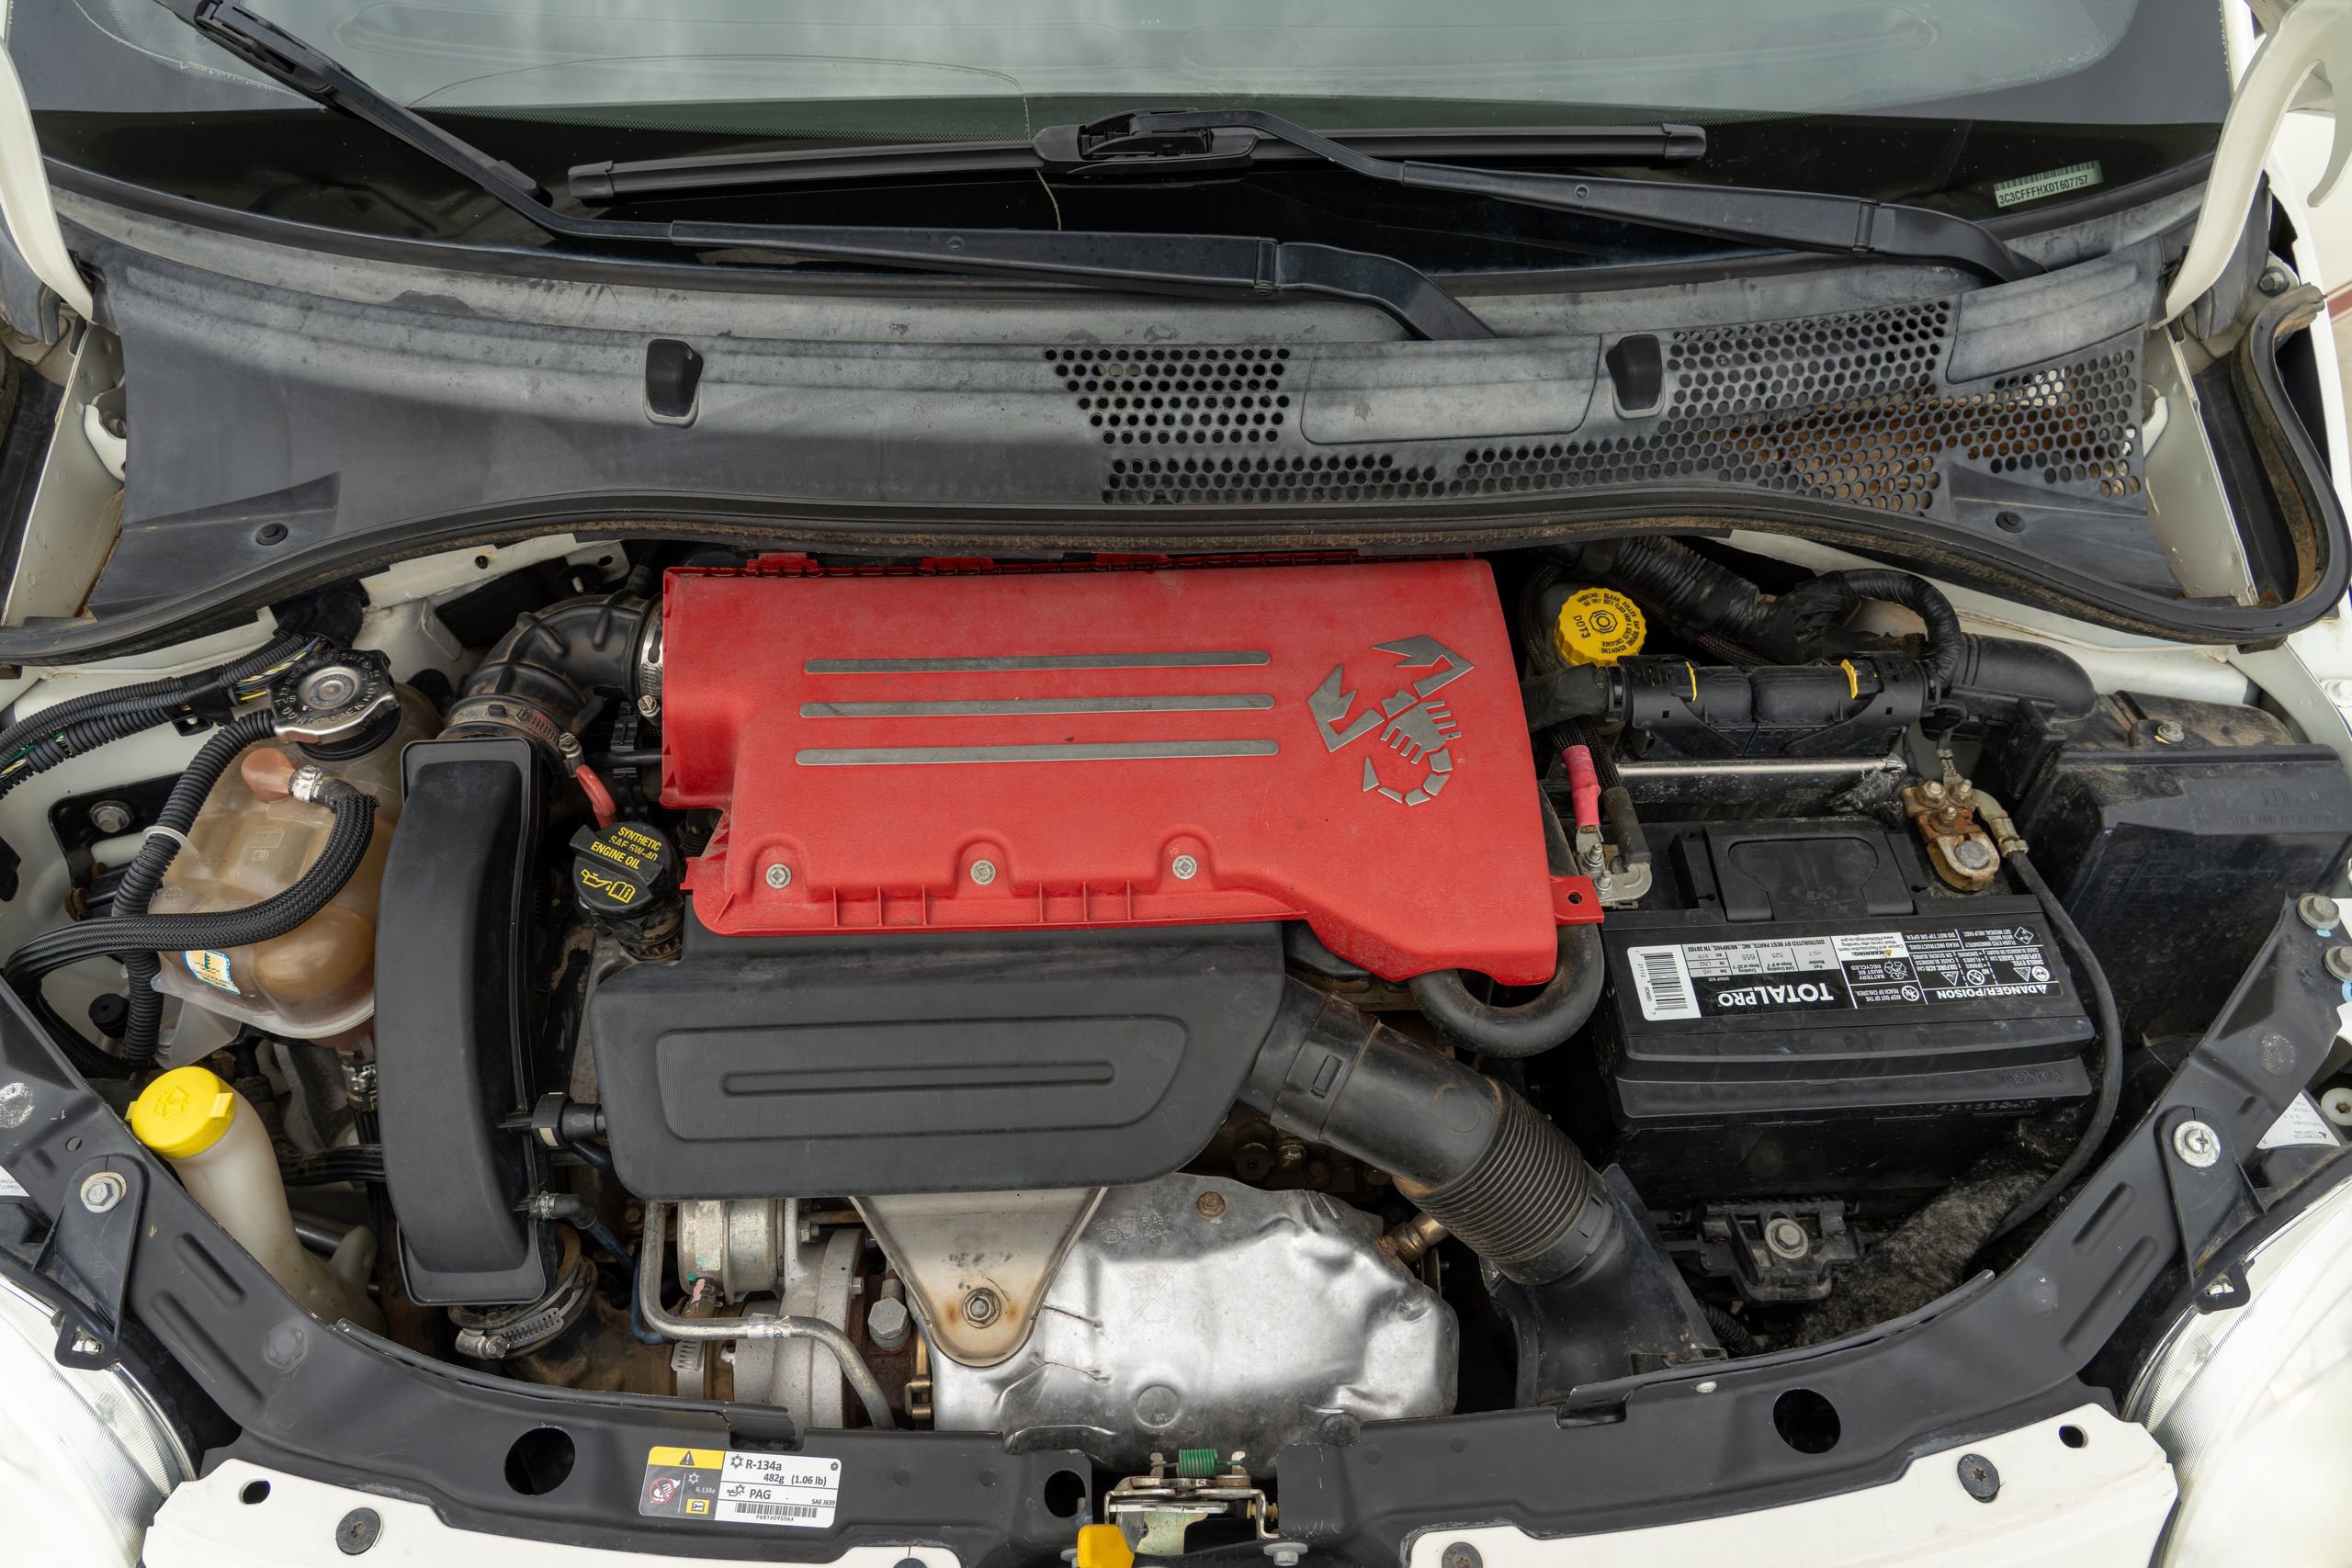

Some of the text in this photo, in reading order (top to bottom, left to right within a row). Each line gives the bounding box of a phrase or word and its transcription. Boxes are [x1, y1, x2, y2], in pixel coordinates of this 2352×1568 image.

[1999, 175, 2087, 204] 3C3CFFFHXDT607757
[617, 827, 662, 851] SYNTHETIC
[591, 841, 639, 869] ENGINE OIL
[628, 844, 658, 862] 5W-40
[1935, 984, 2038, 998] DANGER/POISON
[745, 1460, 782, 1471] R-134a
[763, 1473, 827, 1486] 482g (1.06 lb)
[749, 1489, 771, 1500] PAG
